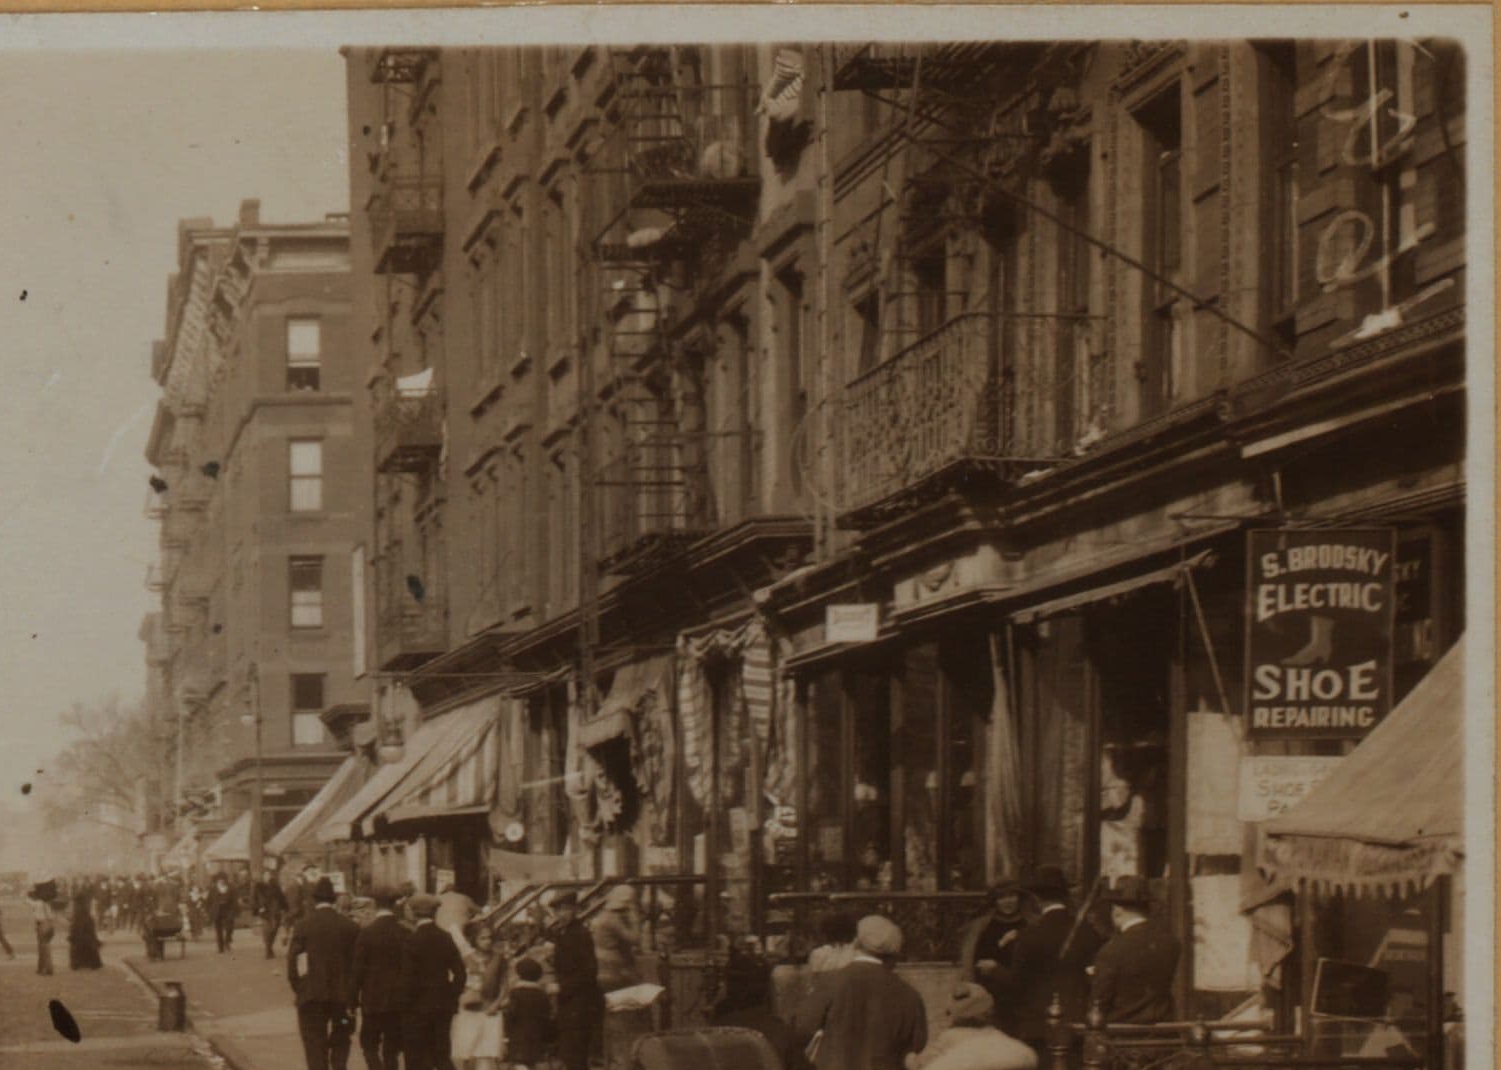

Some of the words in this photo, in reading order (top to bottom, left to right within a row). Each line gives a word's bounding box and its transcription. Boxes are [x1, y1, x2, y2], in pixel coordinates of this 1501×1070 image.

[1257, 582, 1383, 622] ELECTRIC
[1253, 660, 1380, 701] SHOE
[1253, 706, 1376, 728] REPAIRING
